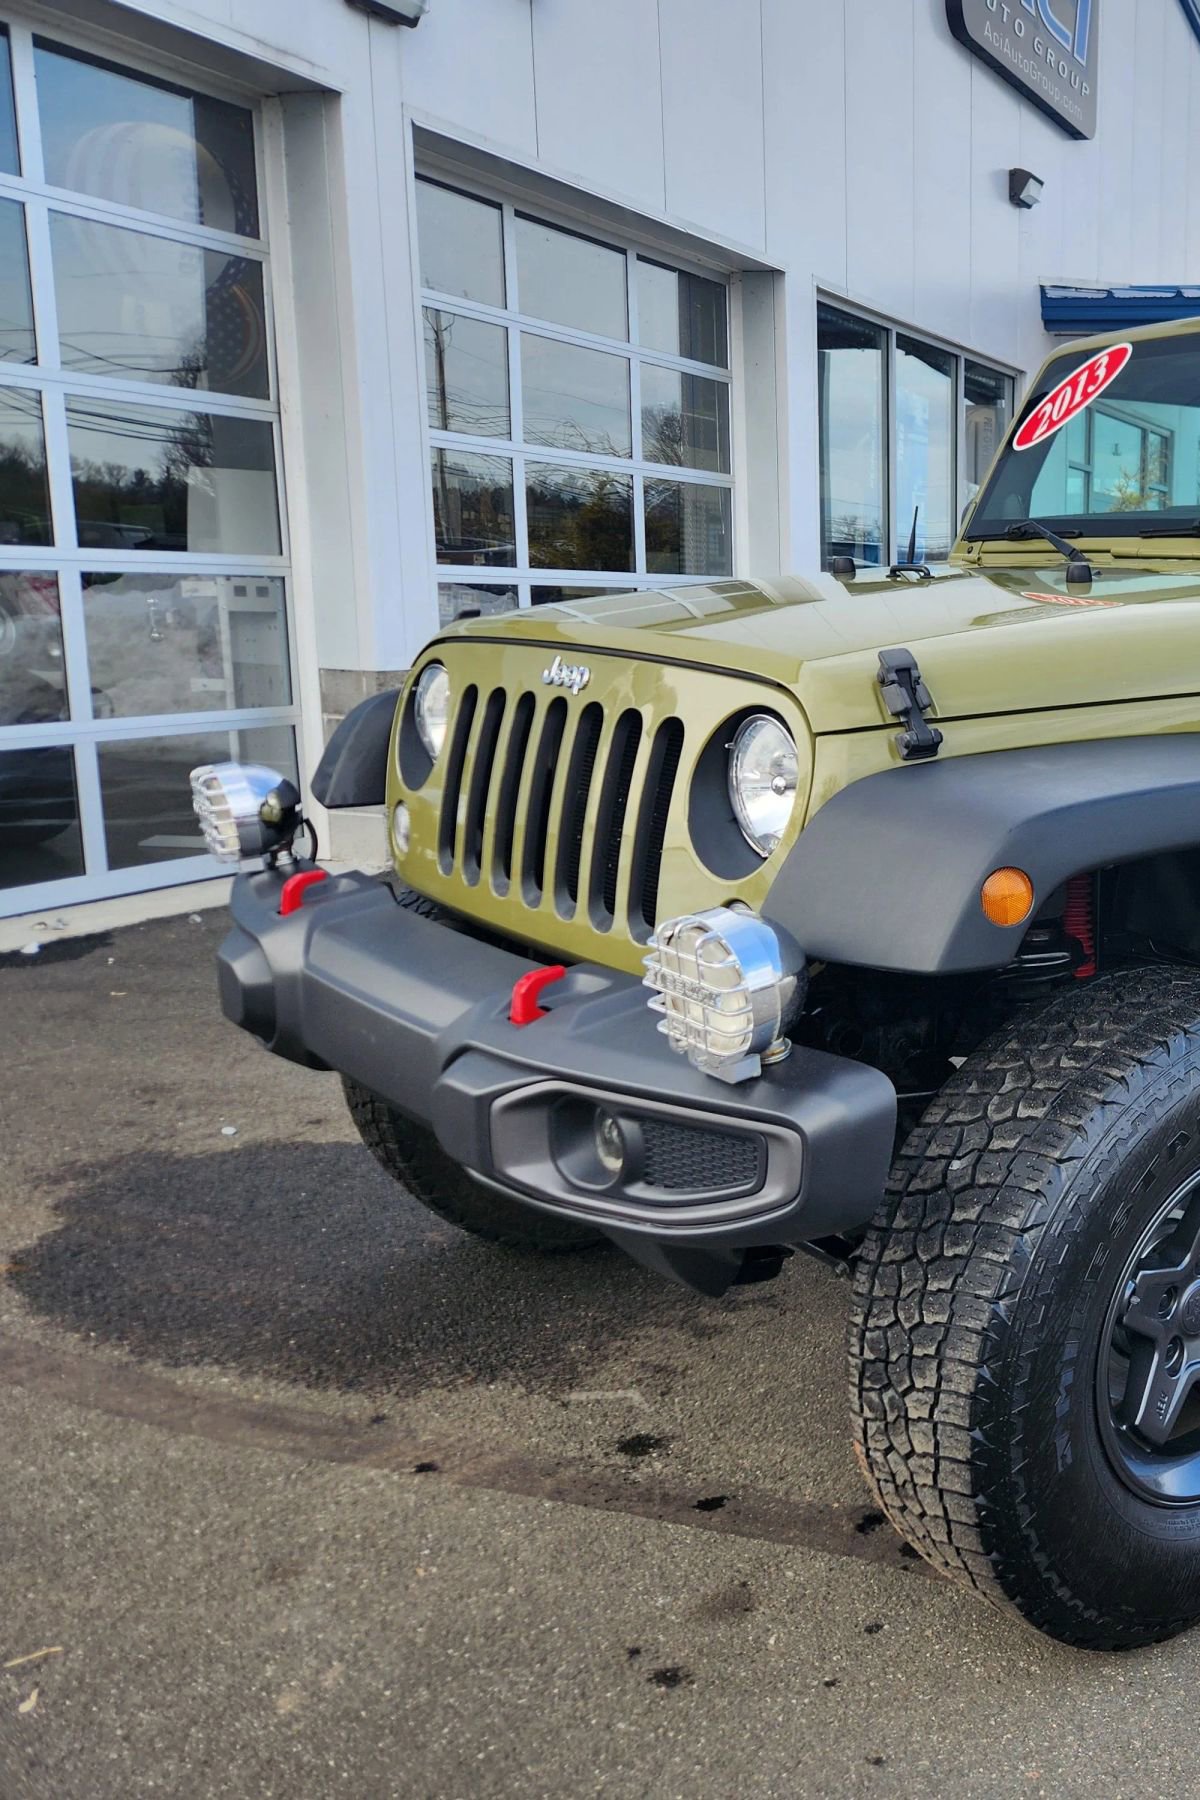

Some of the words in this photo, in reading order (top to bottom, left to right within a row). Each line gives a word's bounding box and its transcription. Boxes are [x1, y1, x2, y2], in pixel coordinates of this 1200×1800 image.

[983, 21, 1083, 120] AciAutoGroup.com
[987, 0, 1025, 38] UTO
[1034, 36, 1090, 97] GROUP
[1032, 354, 1109, 441] 2013
[543, 655, 590, 695] Jeep
